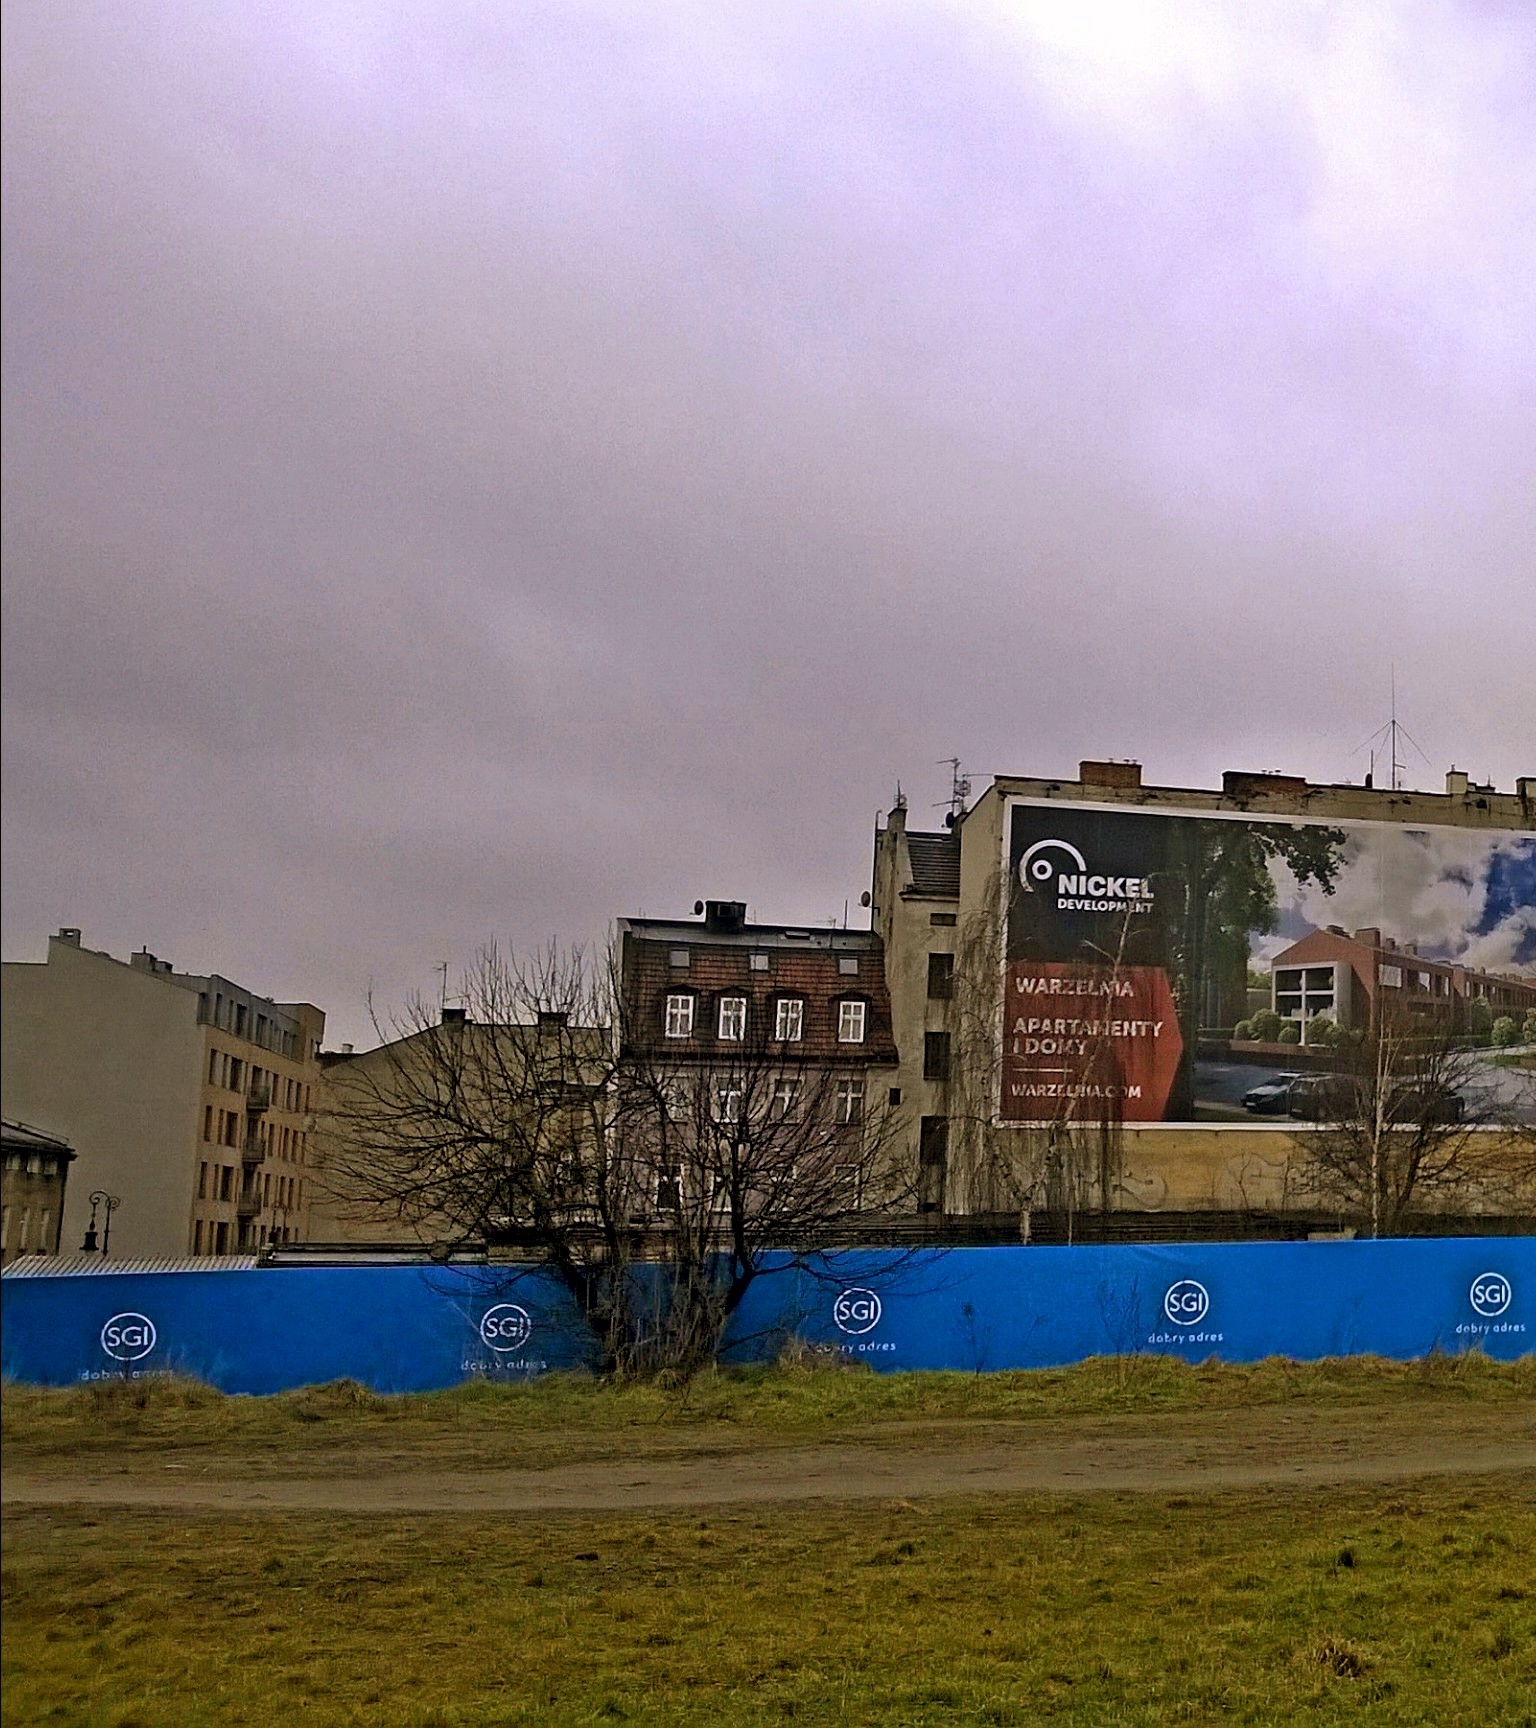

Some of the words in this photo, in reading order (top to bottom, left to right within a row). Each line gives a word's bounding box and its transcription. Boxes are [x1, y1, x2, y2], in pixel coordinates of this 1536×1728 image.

[1057, 873, 1155, 900] NICKEL
[1015, 976, 1135, 998] WARZELNIA
[1012, 1017, 1164, 1038] APARTAMENTY
[1012, 1037, 1020, 1054] I
[1011, 1083, 1142, 1099] WARZELNIA.CM
[1169, 1292, 1203, 1312] SGI
[1474, 1284, 1506, 1304] SGI
[838, 1300, 875, 1320] SGI
[107, 1325, 149, 1347] SGI
[485, 1317, 525, 1338] SGI
[1455, 1323, 1490, 1335] dobry
[1492, 1322, 1526, 1332] adres
[858, 1340, 896, 1351] adres
[1148, 1333, 1185, 1344] dobry
[1188, 1332, 1224, 1342] adres
[80, 1369, 124, 1381] doby
